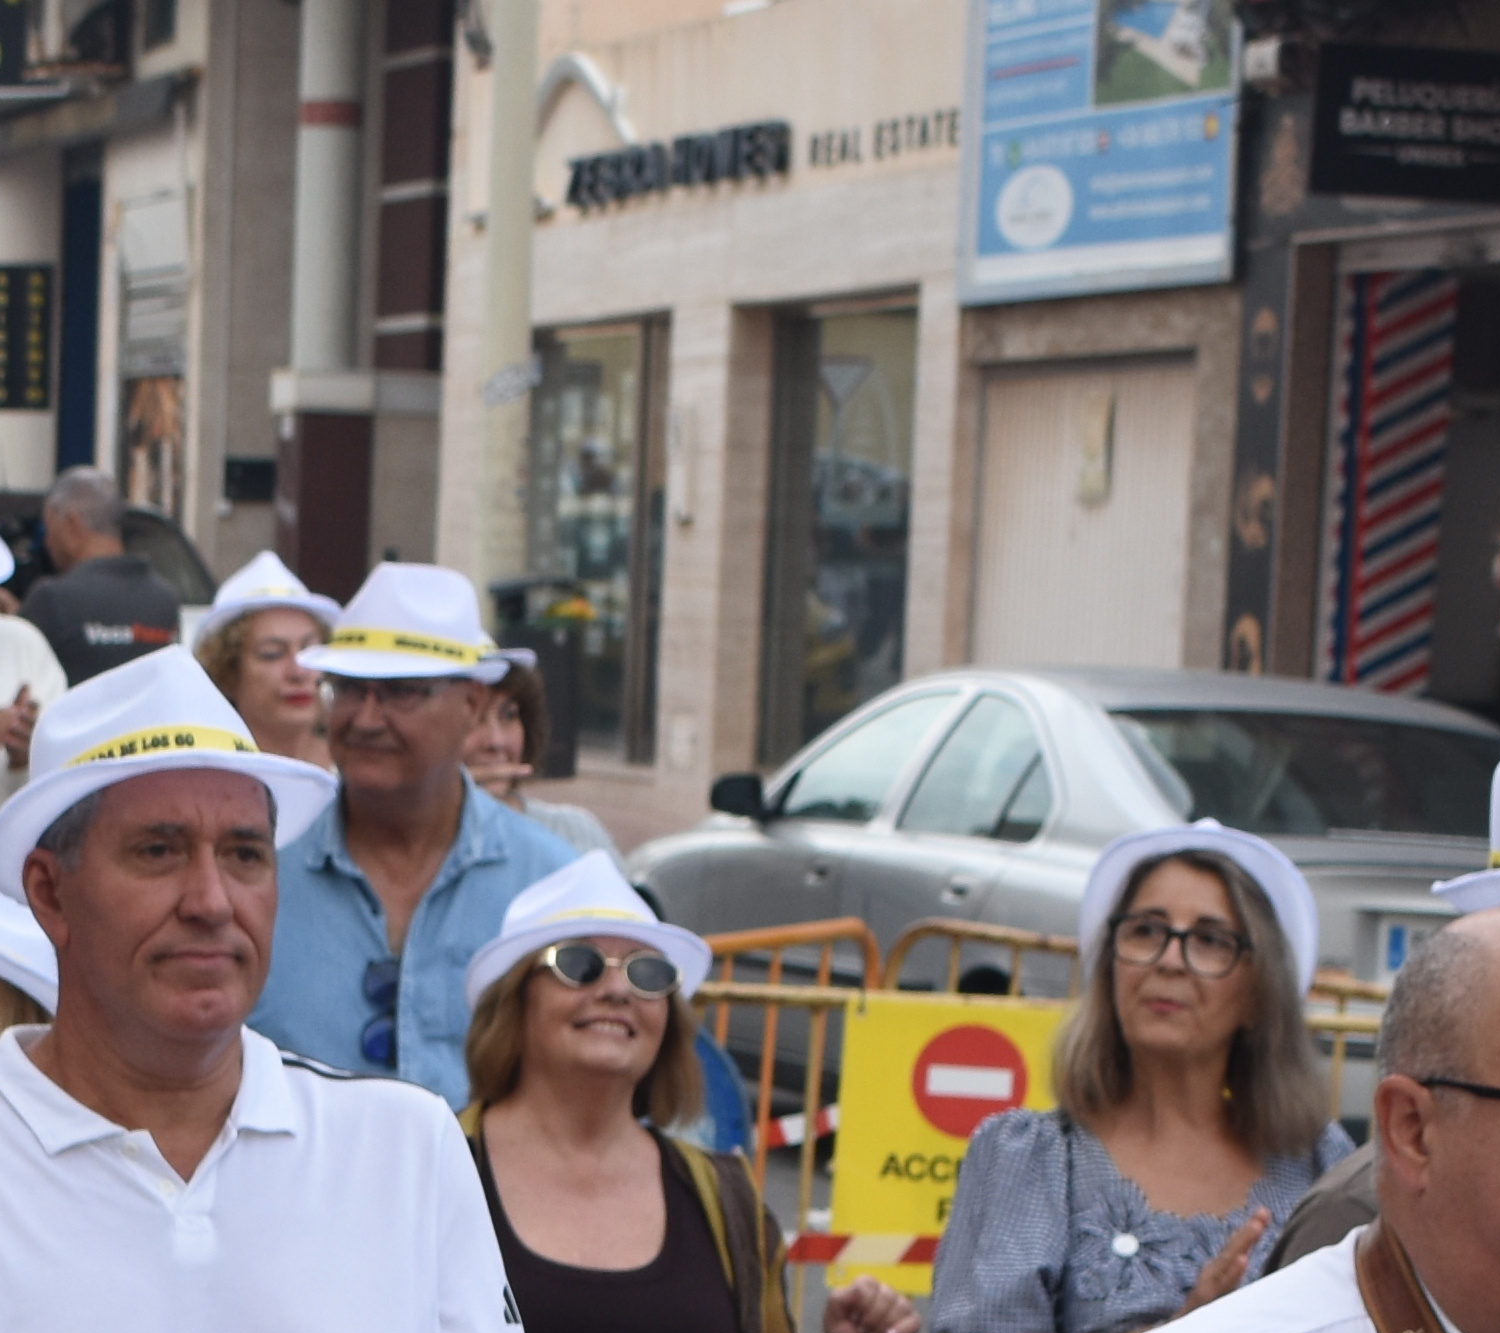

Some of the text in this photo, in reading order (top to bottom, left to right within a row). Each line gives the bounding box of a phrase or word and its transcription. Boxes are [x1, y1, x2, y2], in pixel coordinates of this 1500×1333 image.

[809, 127, 864, 168] REAL
[873, 106, 960, 162] ESTATE
[1339, 106, 1446, 140] BARBER
[120, 739, 138, 756] DE
[141, 734, 170, 750] LOS
